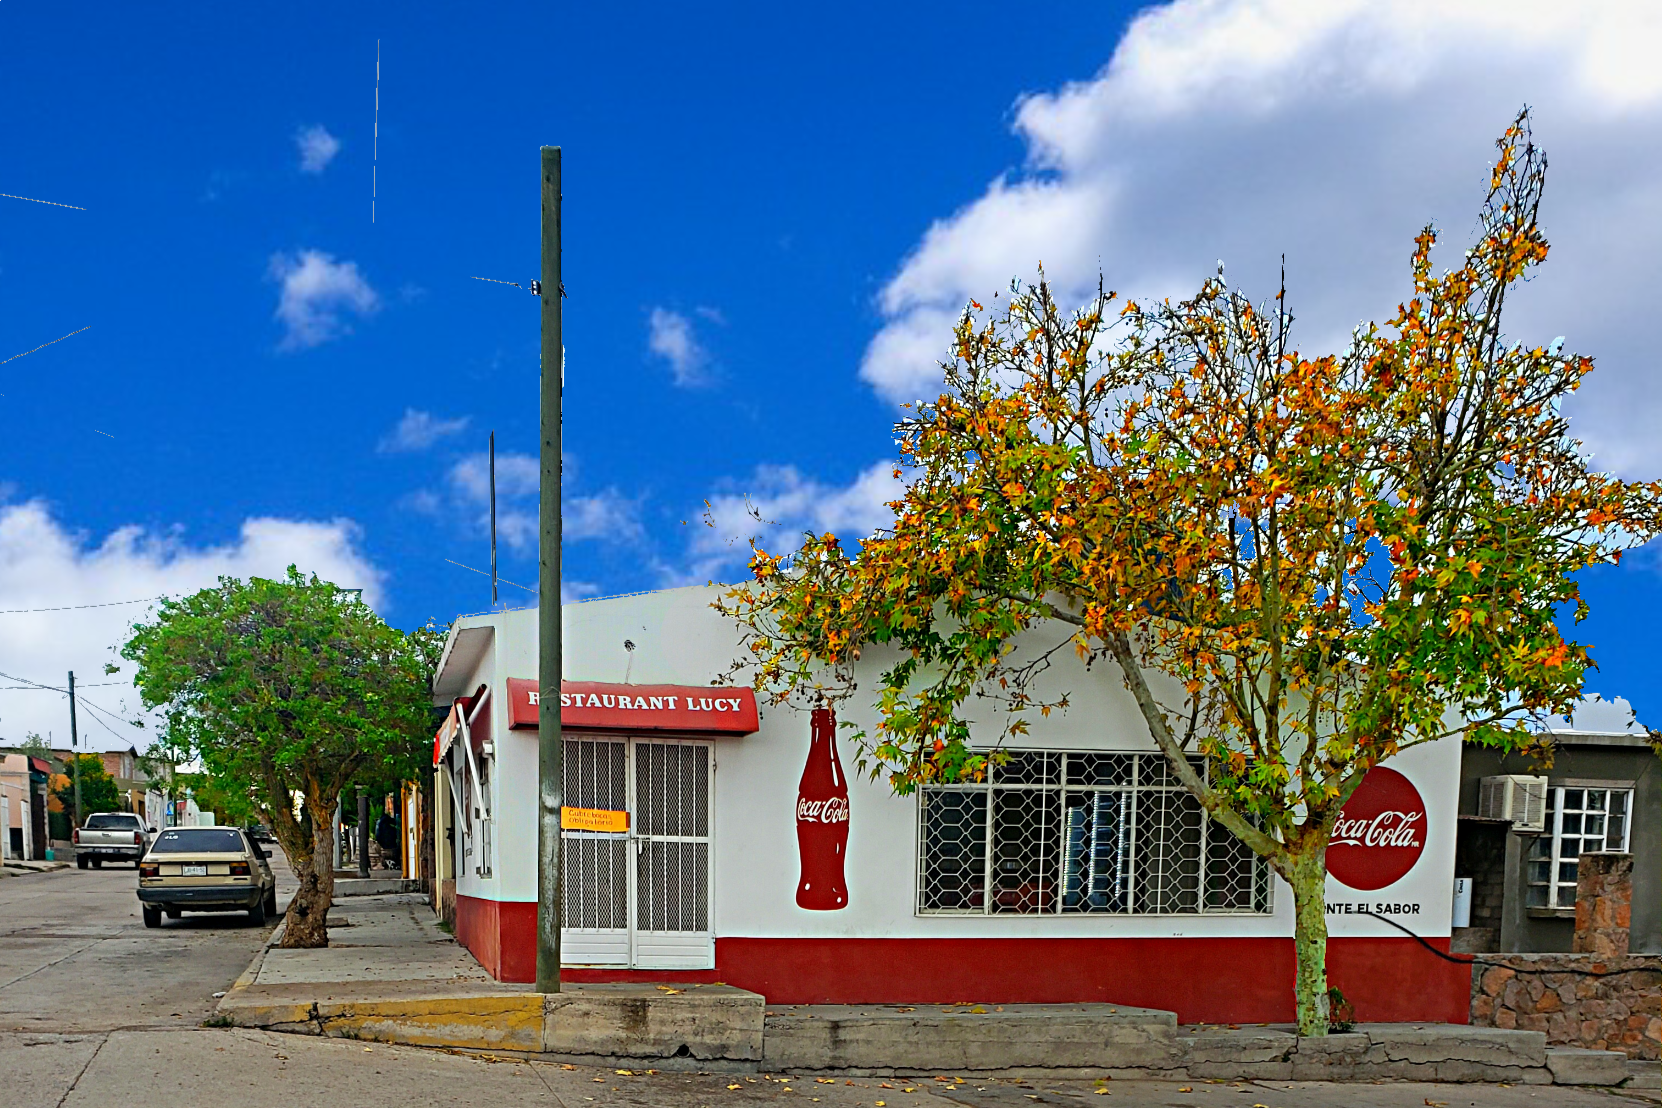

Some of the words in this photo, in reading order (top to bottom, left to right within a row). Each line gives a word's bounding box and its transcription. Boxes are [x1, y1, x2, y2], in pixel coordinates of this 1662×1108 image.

[528, 691, 678, 710] RSTAURANT
[686, 697, 741, 711] LUCY
[797, 796, 848, 823] Coca-Cola
[1325, 903, 1352, 914] NTE
[1357, 903, 1372, 914] EL
[1375, 903, 1420, 914] SABOR
